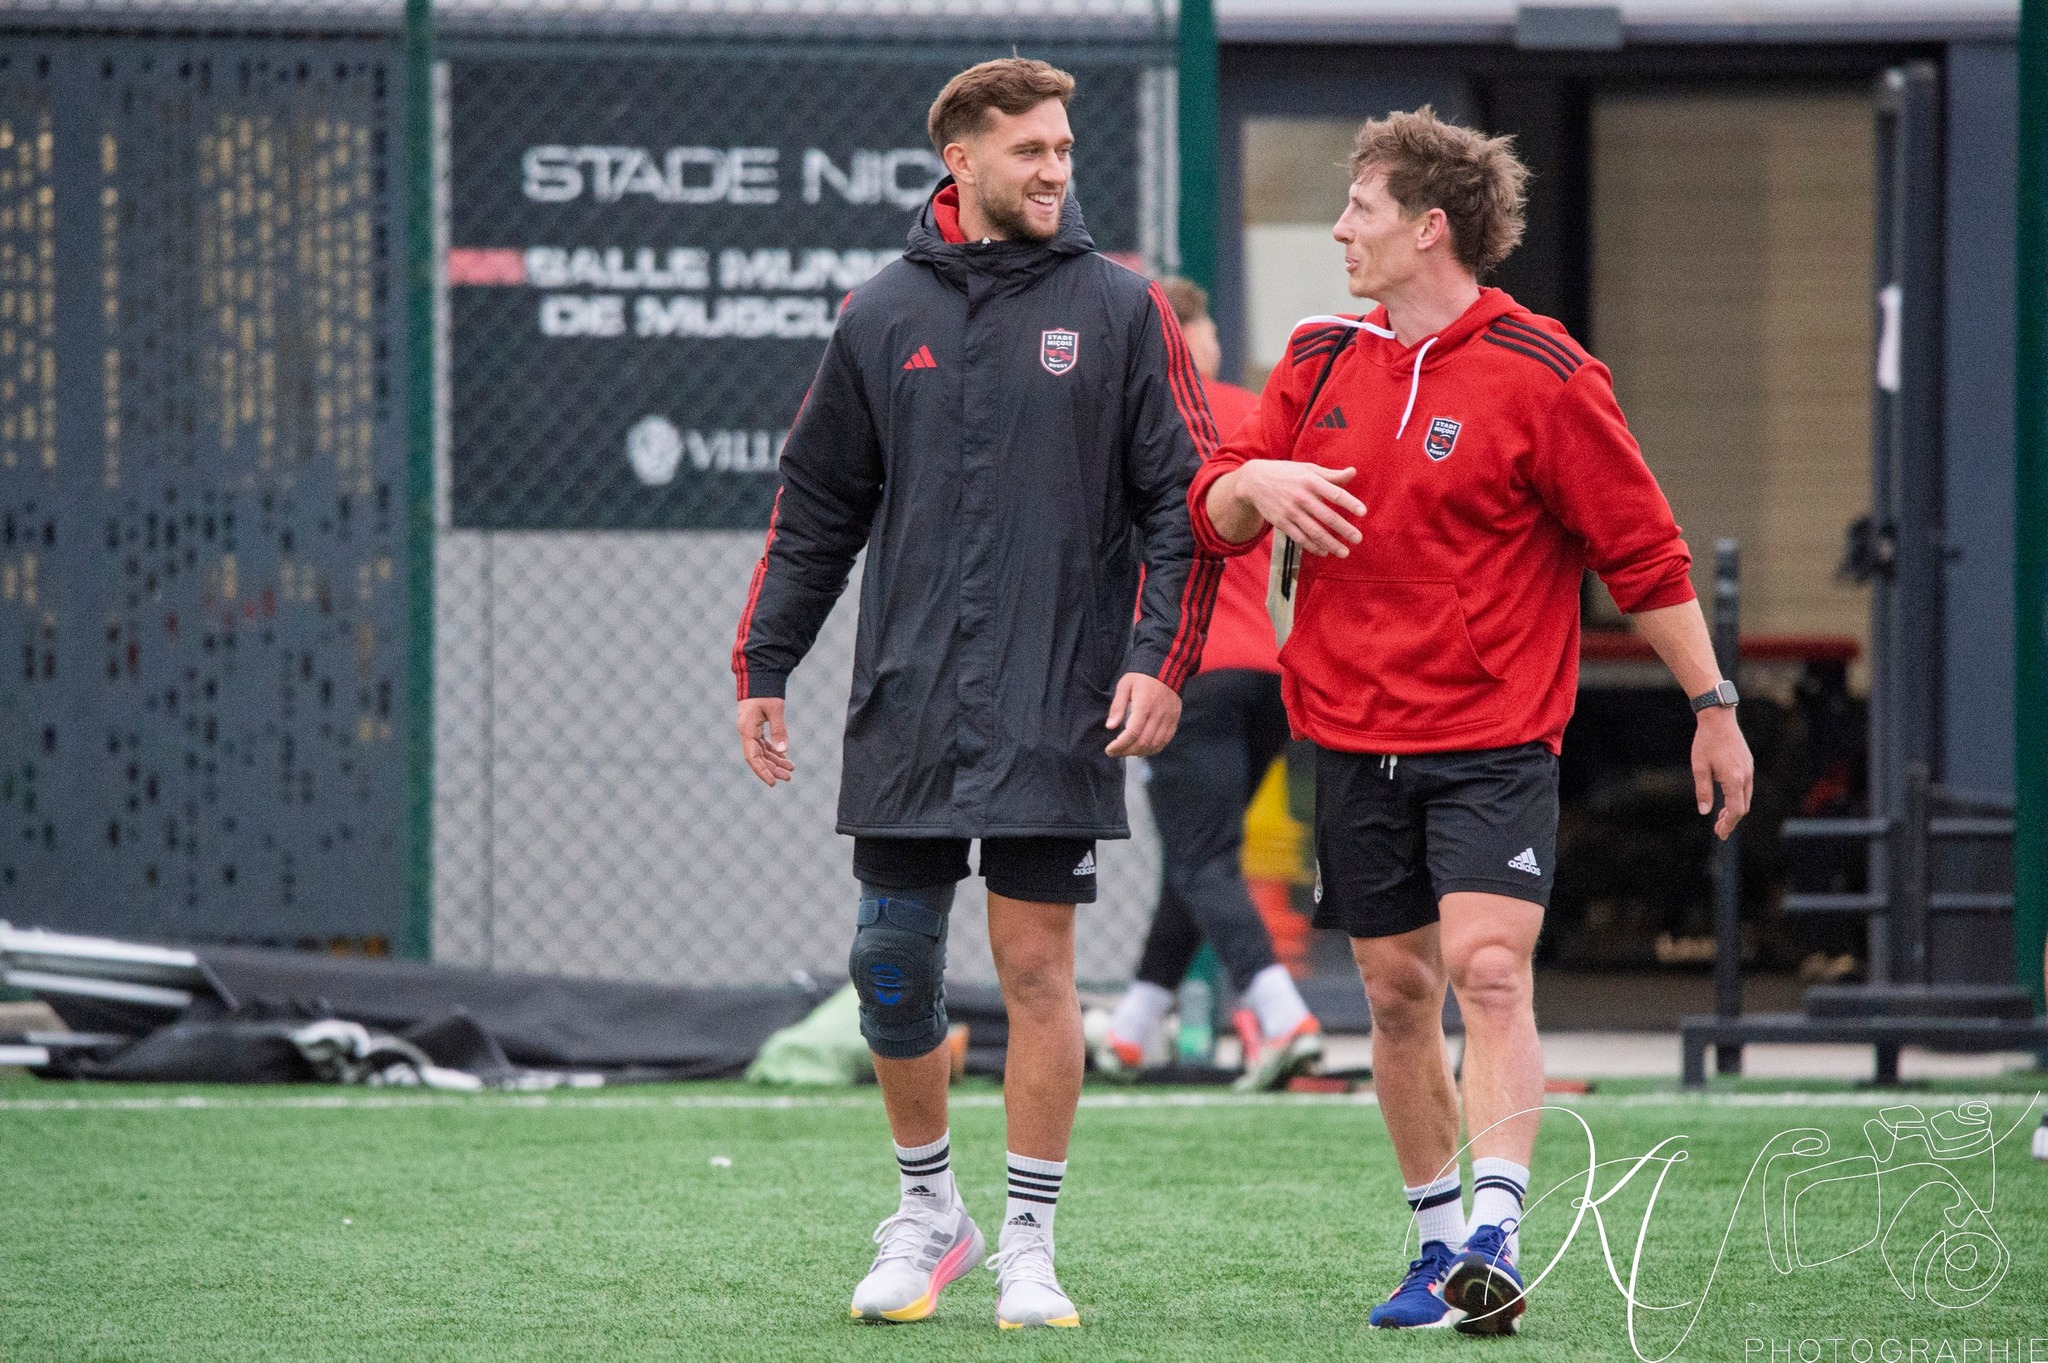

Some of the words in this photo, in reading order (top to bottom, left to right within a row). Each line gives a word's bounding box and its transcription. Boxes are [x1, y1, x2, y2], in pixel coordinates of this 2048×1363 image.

[522, 145, 780, 204] STADE
[526, 247, 710, 289] SALLE
[539, 295, 626, 337] DE
[1433, 426, 1456, 436] NIÇOIS
[1435, 421, 1458, 430] STADE
[1508, 860, 1541, 876] adidas
